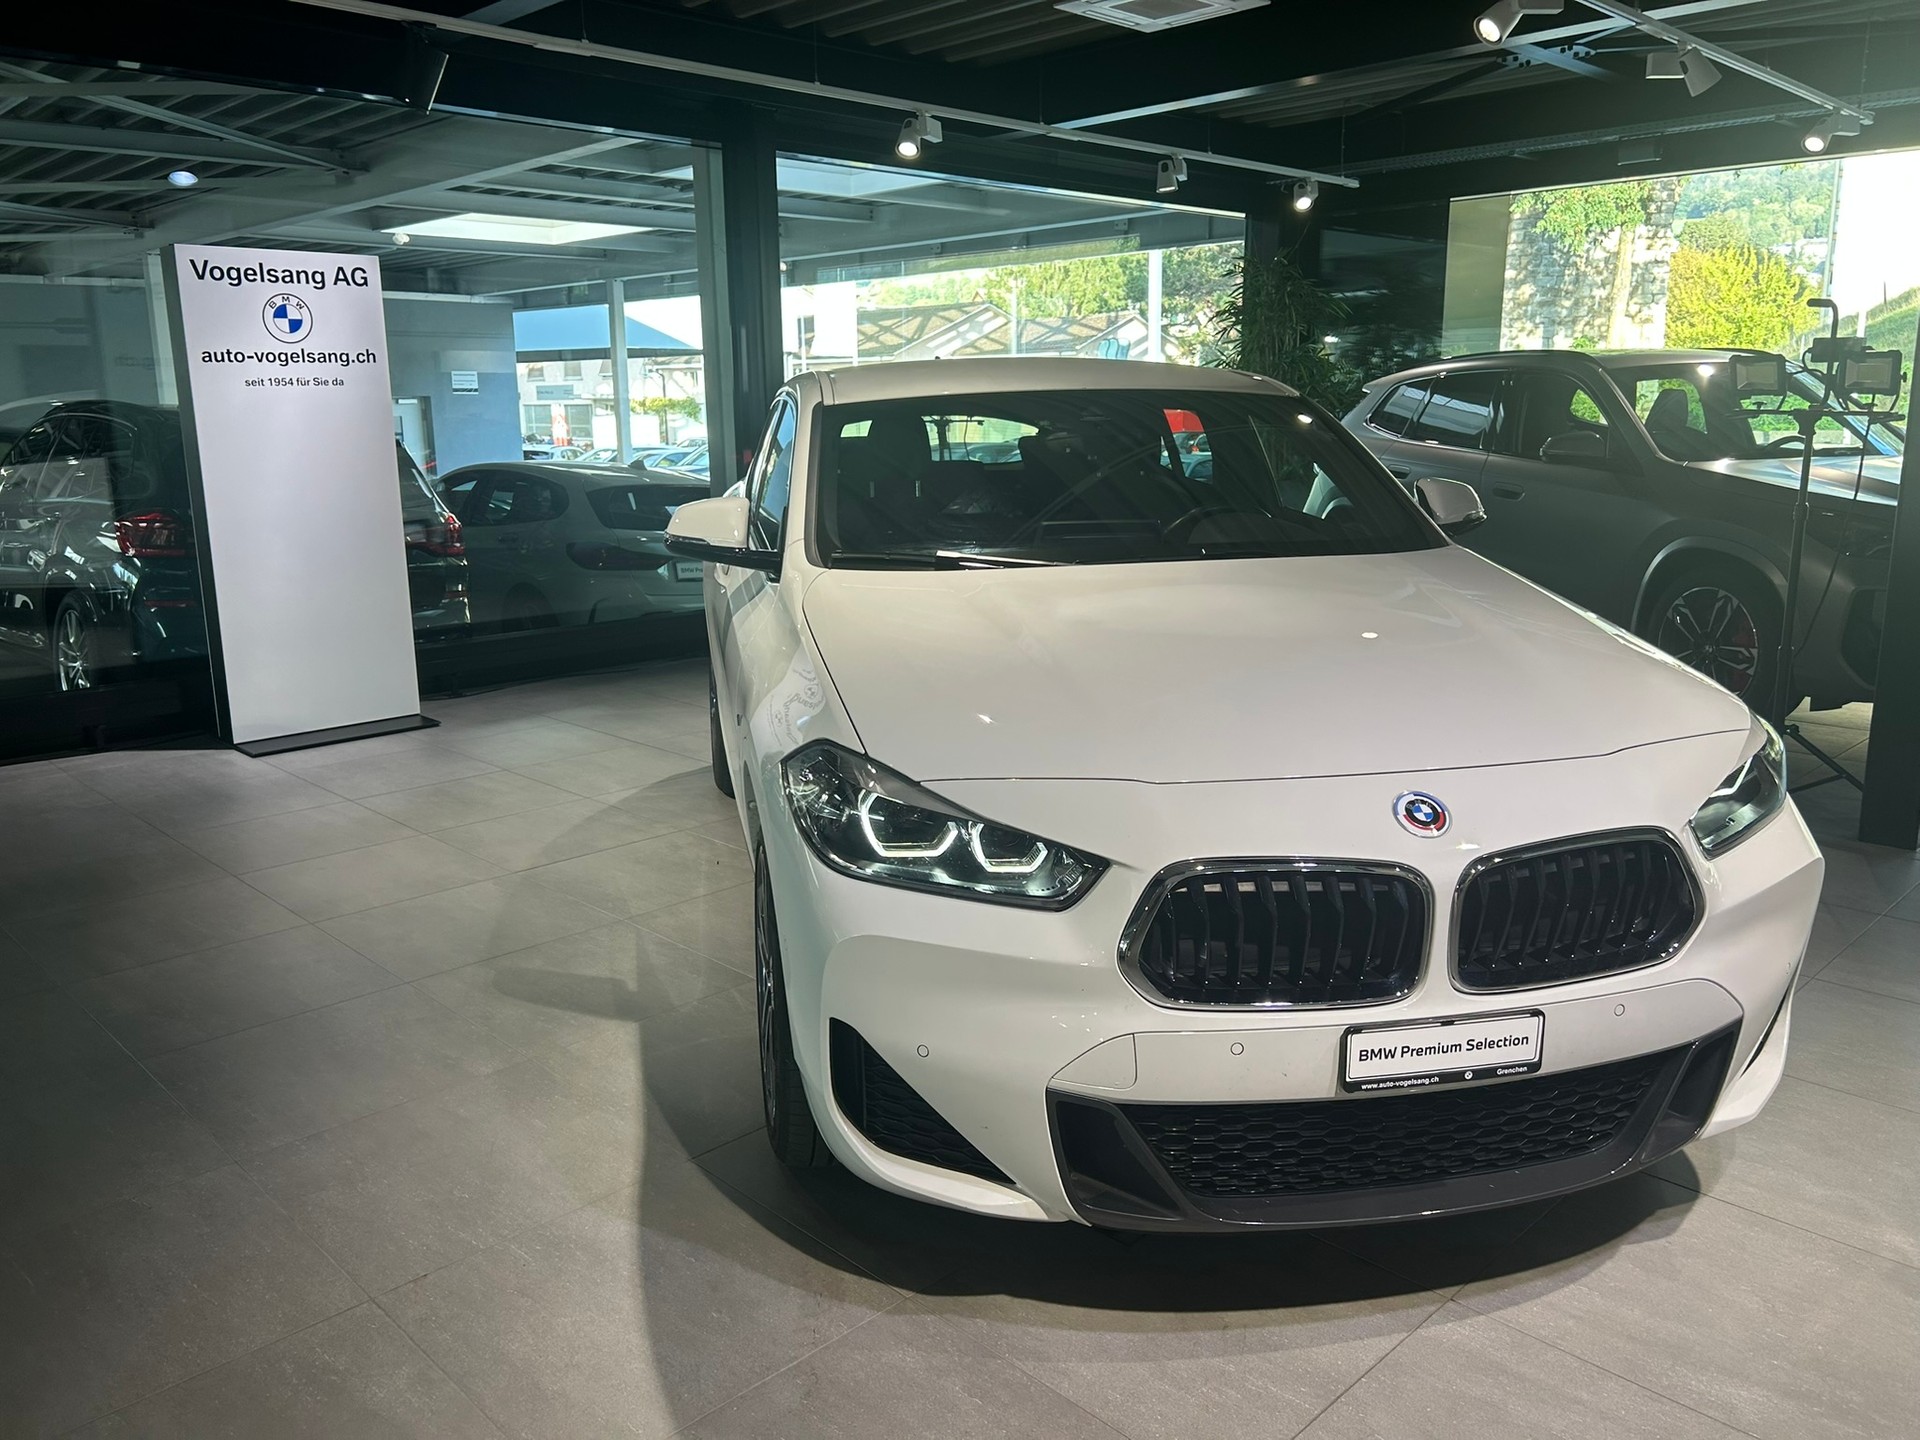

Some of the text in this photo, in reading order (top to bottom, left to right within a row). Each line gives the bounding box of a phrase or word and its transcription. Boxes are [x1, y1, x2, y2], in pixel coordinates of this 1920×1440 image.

[189, 259, 369, 290] Vogelsang AG
[268, 296, 305, 310] BMW
[201, 348, 377, 367] auto-vogelsang.ch
[245, 377, 344, 387] seit 1954 für Sie da
[1359, 1035, 1529, 1062] BMW Premium Selection
[1360, 1066, 1528, 1090] www.auto-vogelsang.ch Grenchen
